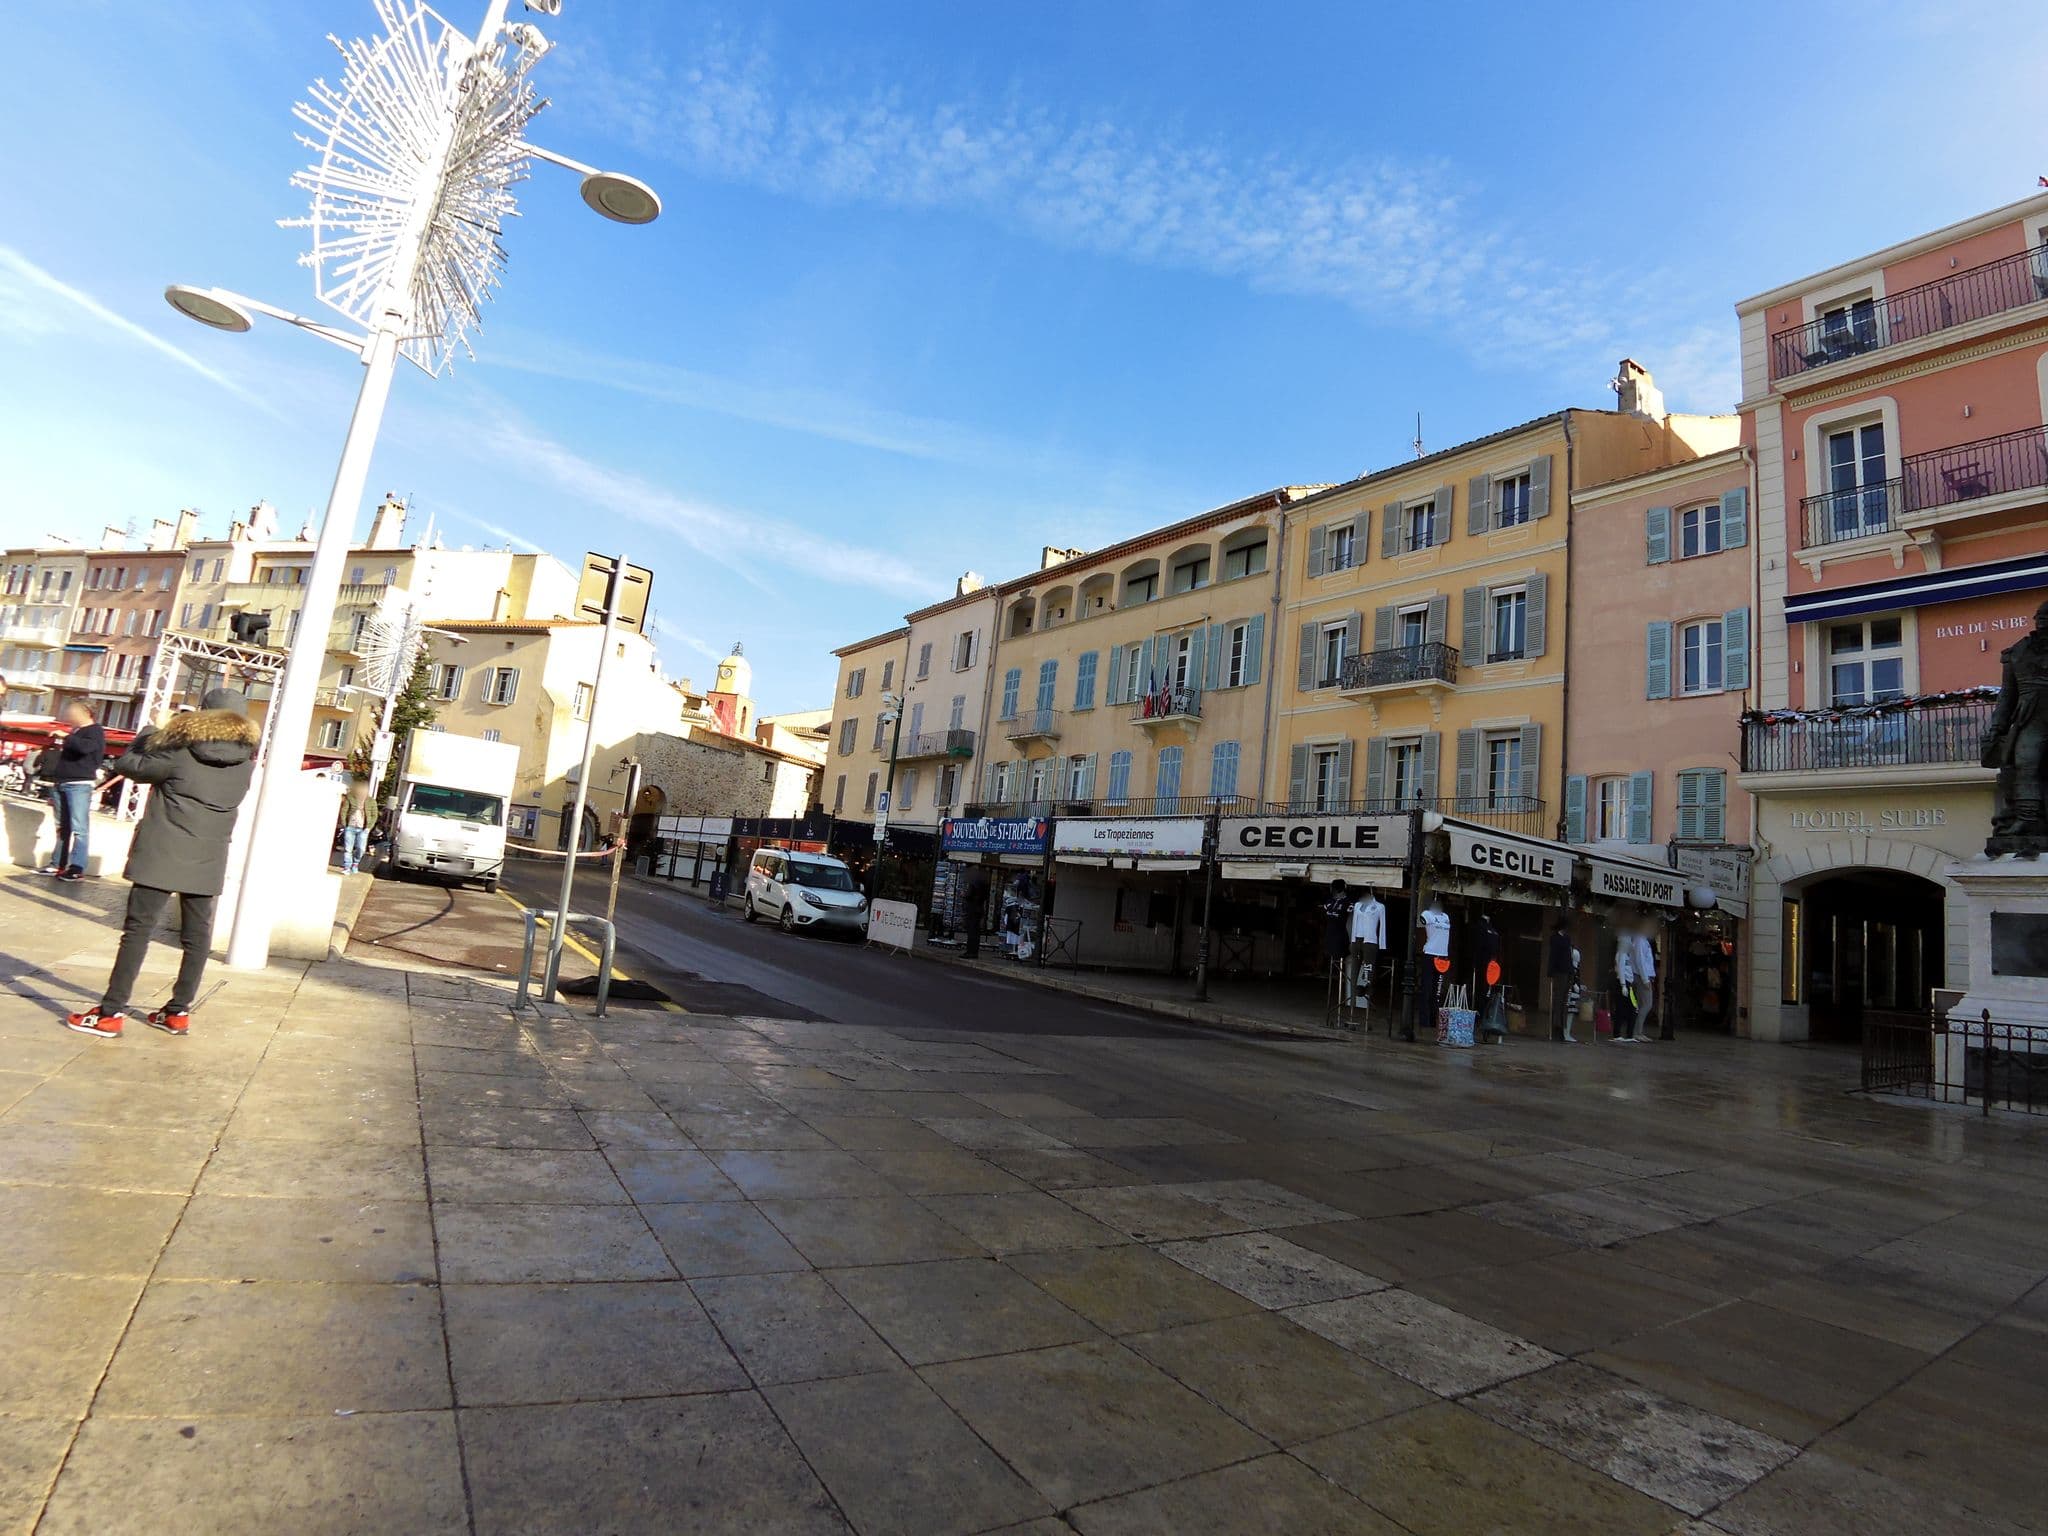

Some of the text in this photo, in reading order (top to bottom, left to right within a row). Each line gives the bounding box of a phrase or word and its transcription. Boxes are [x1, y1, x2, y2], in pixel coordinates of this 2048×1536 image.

[1936, 616, 2029, 638] BAR DU SUBE
[1880, 808, 1948, 826] SUBE
[952, 822, 989, 839] SOUVENIRS
[1094, 829, 1155, 841] Les Tropeziennes
[1240, 826, 1379, 848] CECILE
[1471, 844, 1554, 878] CECILE
[1603, 873, 1673, 901] PASSAGE DU PORT
